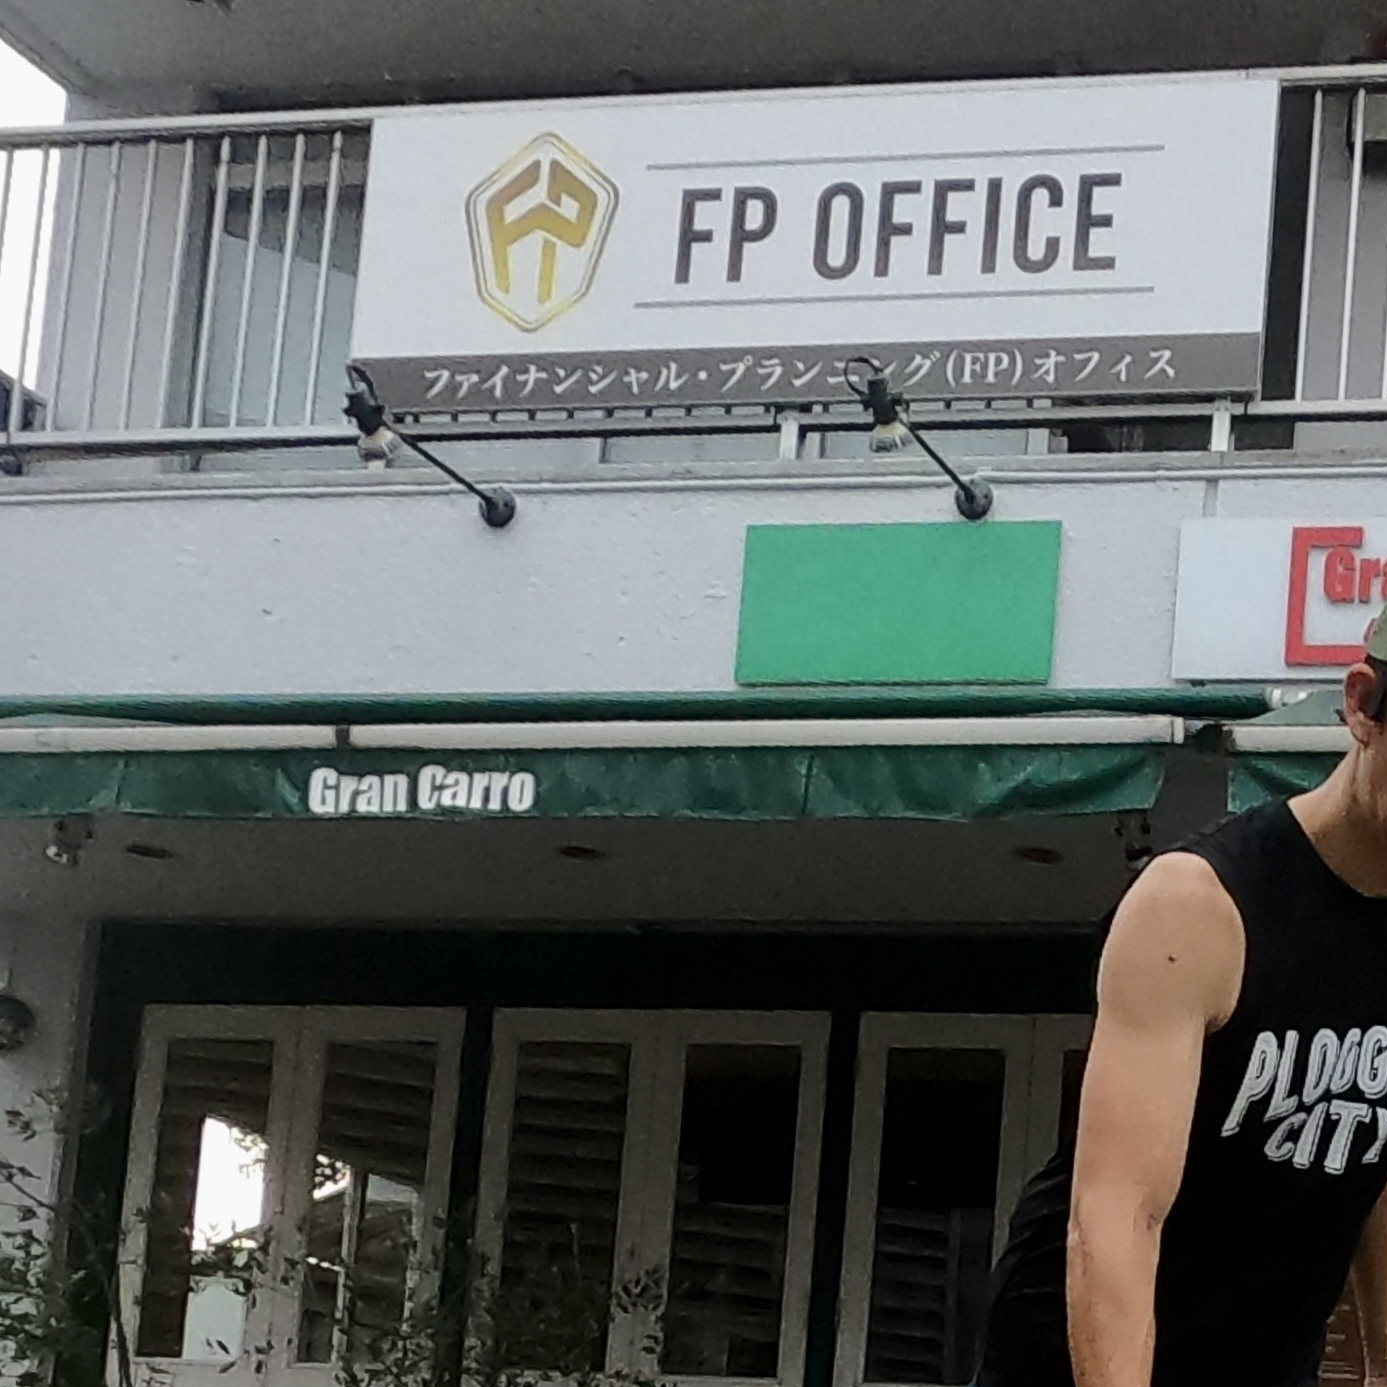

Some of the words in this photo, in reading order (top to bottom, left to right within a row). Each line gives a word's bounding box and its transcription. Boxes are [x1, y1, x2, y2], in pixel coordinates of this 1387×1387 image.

[674, 186, 778, 284] FP
[812, 173, 1122, 280] OFFICE
[308, 766, 409, 815] Gran
[417, 764, 537, 812] Carro
